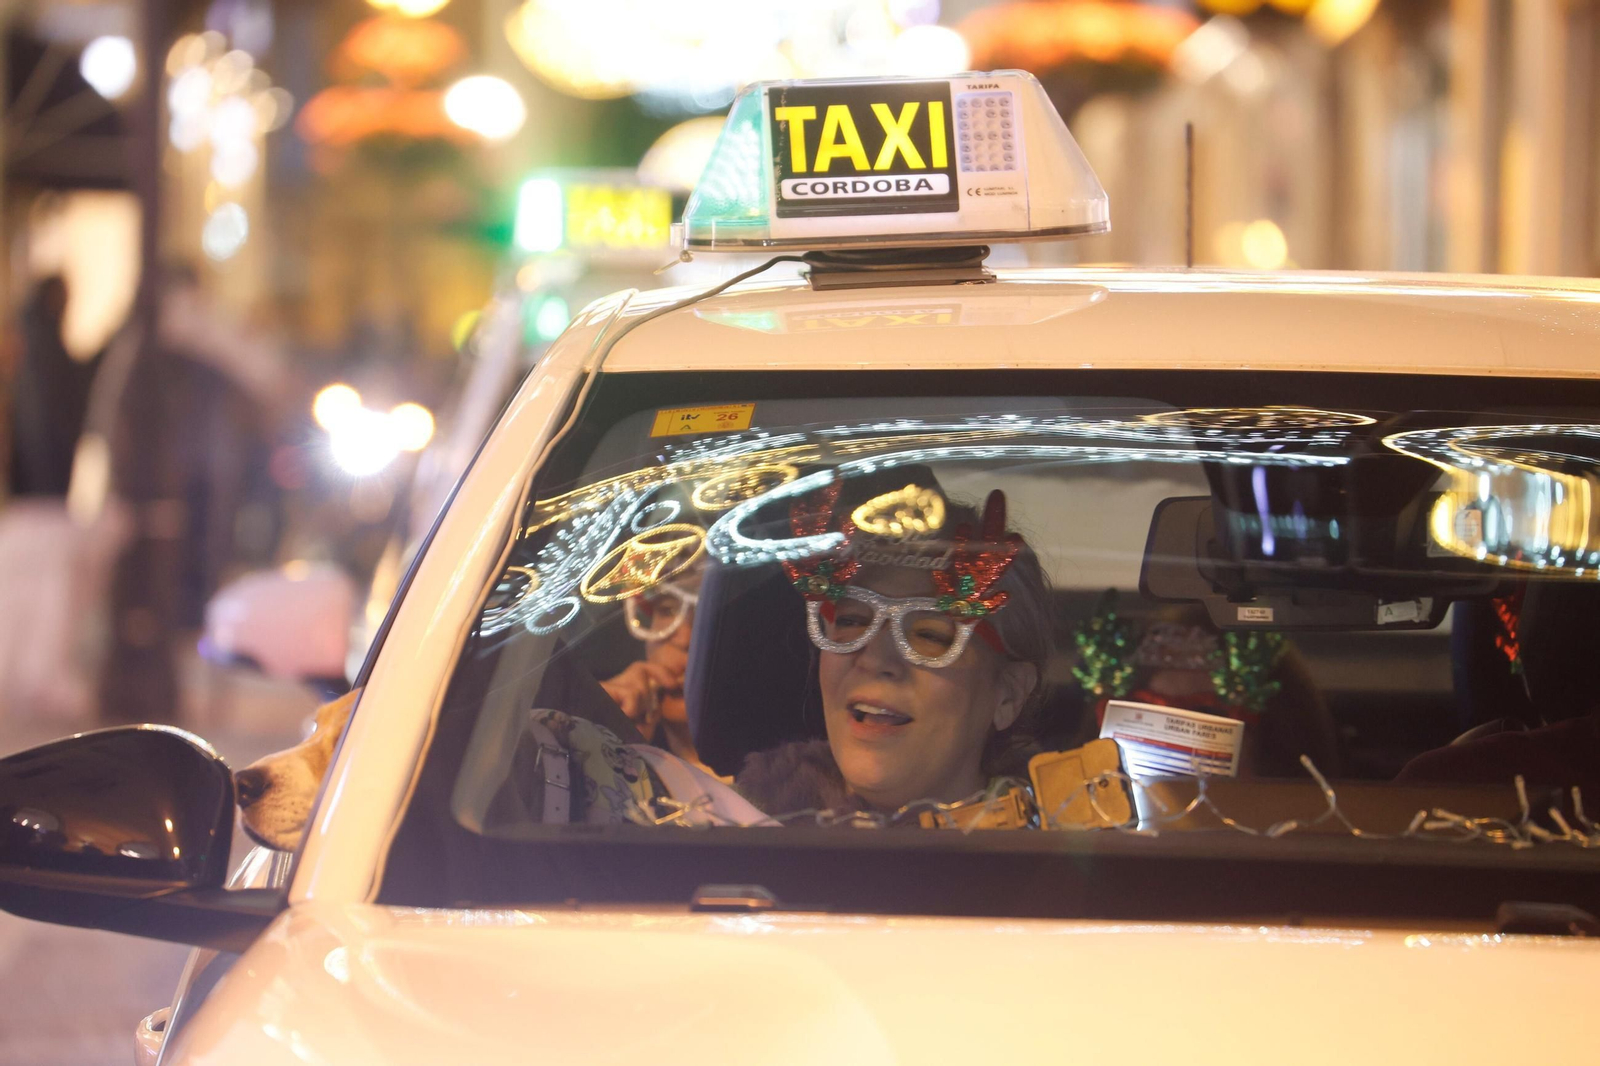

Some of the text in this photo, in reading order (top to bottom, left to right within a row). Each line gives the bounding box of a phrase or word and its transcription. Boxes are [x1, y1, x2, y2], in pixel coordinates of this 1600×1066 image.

[775, 100, 948, 173] TAXI
[790, 177, 934, 197] CORDOBA
[715, 412, 739, 422] 26
[1192, 729, 1217, 740] FARES
